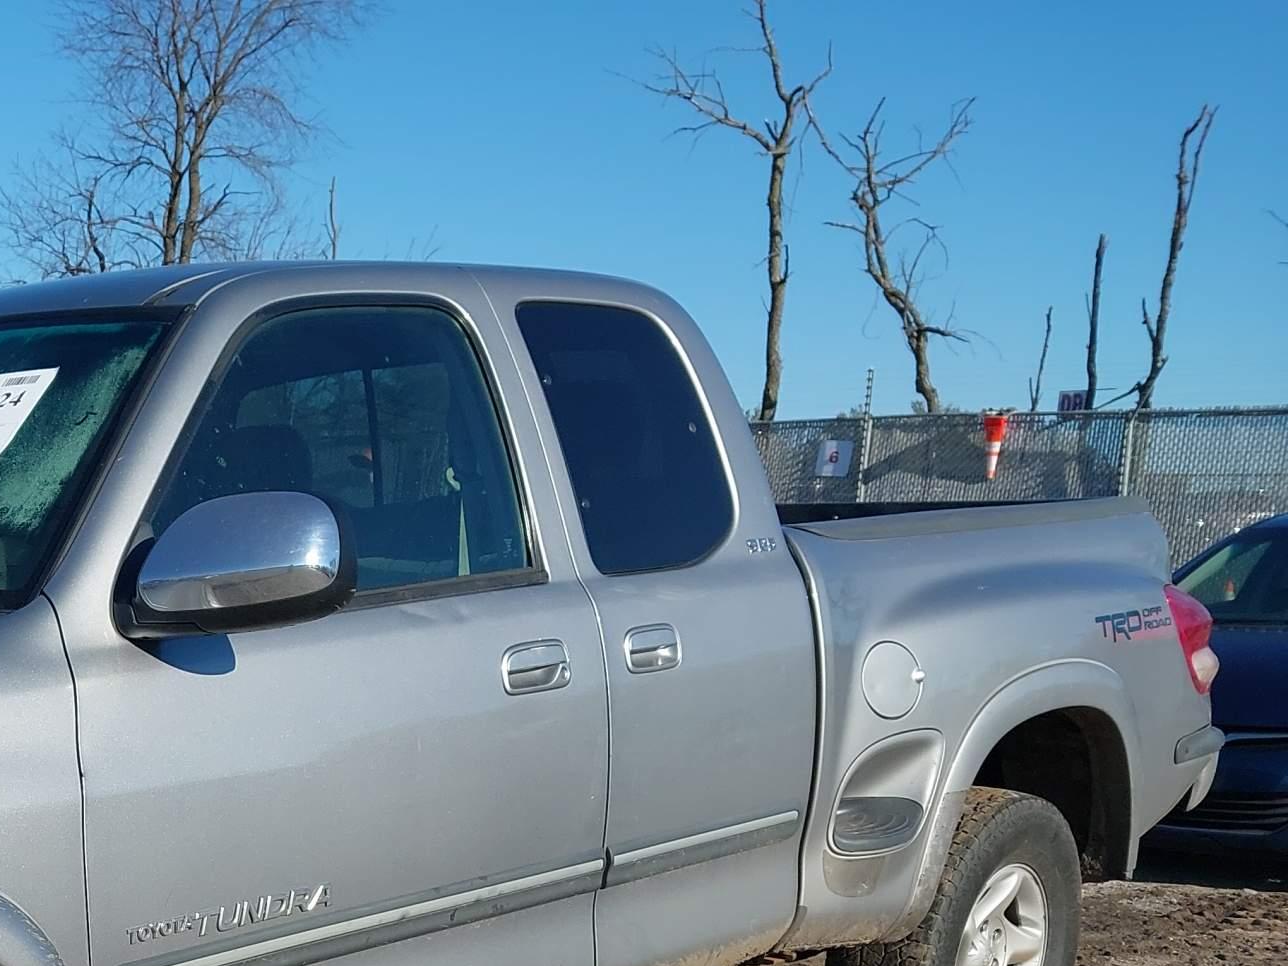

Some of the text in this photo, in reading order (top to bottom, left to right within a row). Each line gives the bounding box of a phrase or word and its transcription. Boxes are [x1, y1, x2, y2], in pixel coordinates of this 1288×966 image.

[1095, 605, 1162, 643] TRD OFF
[126, 882, 332, 945] TOYOTA TUNDRA
